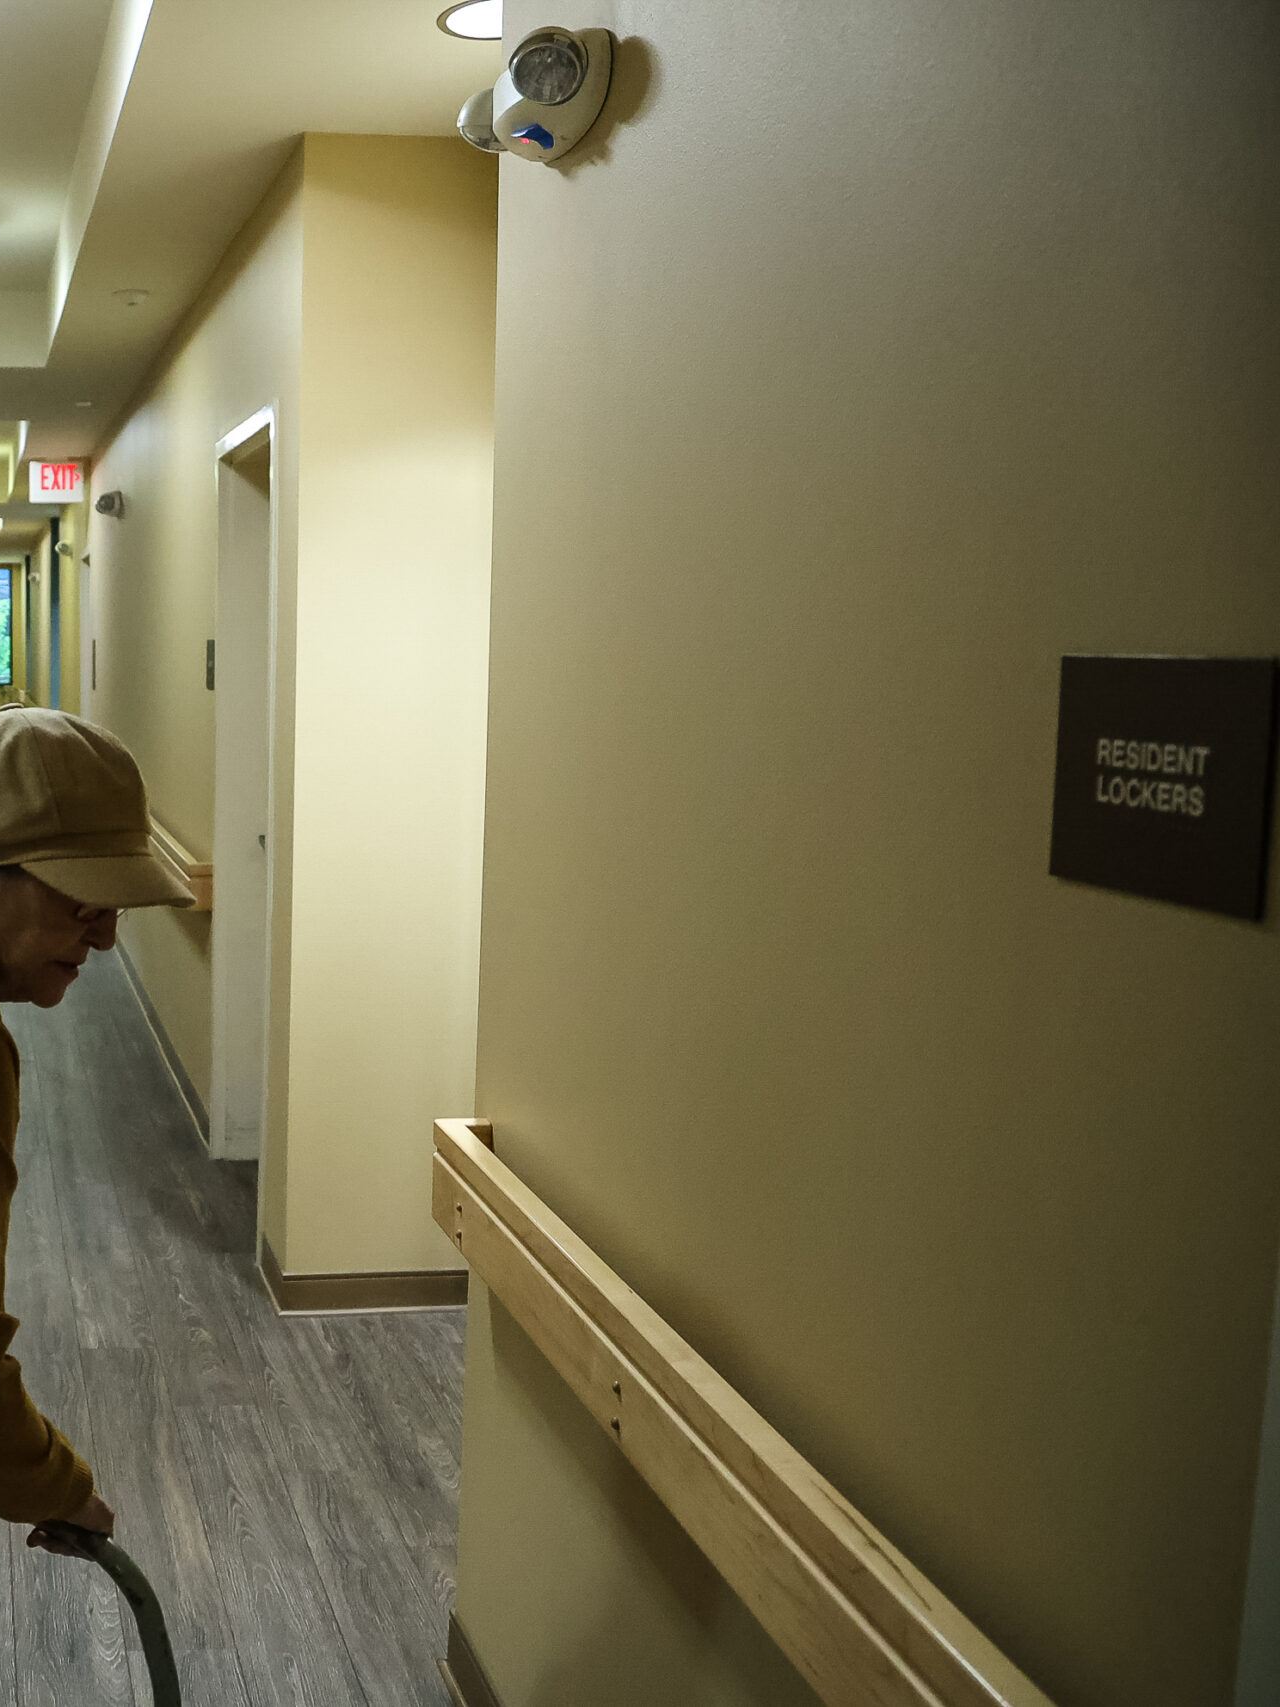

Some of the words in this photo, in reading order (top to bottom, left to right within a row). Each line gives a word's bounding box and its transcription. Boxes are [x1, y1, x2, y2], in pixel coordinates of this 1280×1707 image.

[41, 464, 77, 490] EXIT
[1096, 738, 1210, 776] RESIDENT
[1096, 776, 1205, 817] LOCKERS
